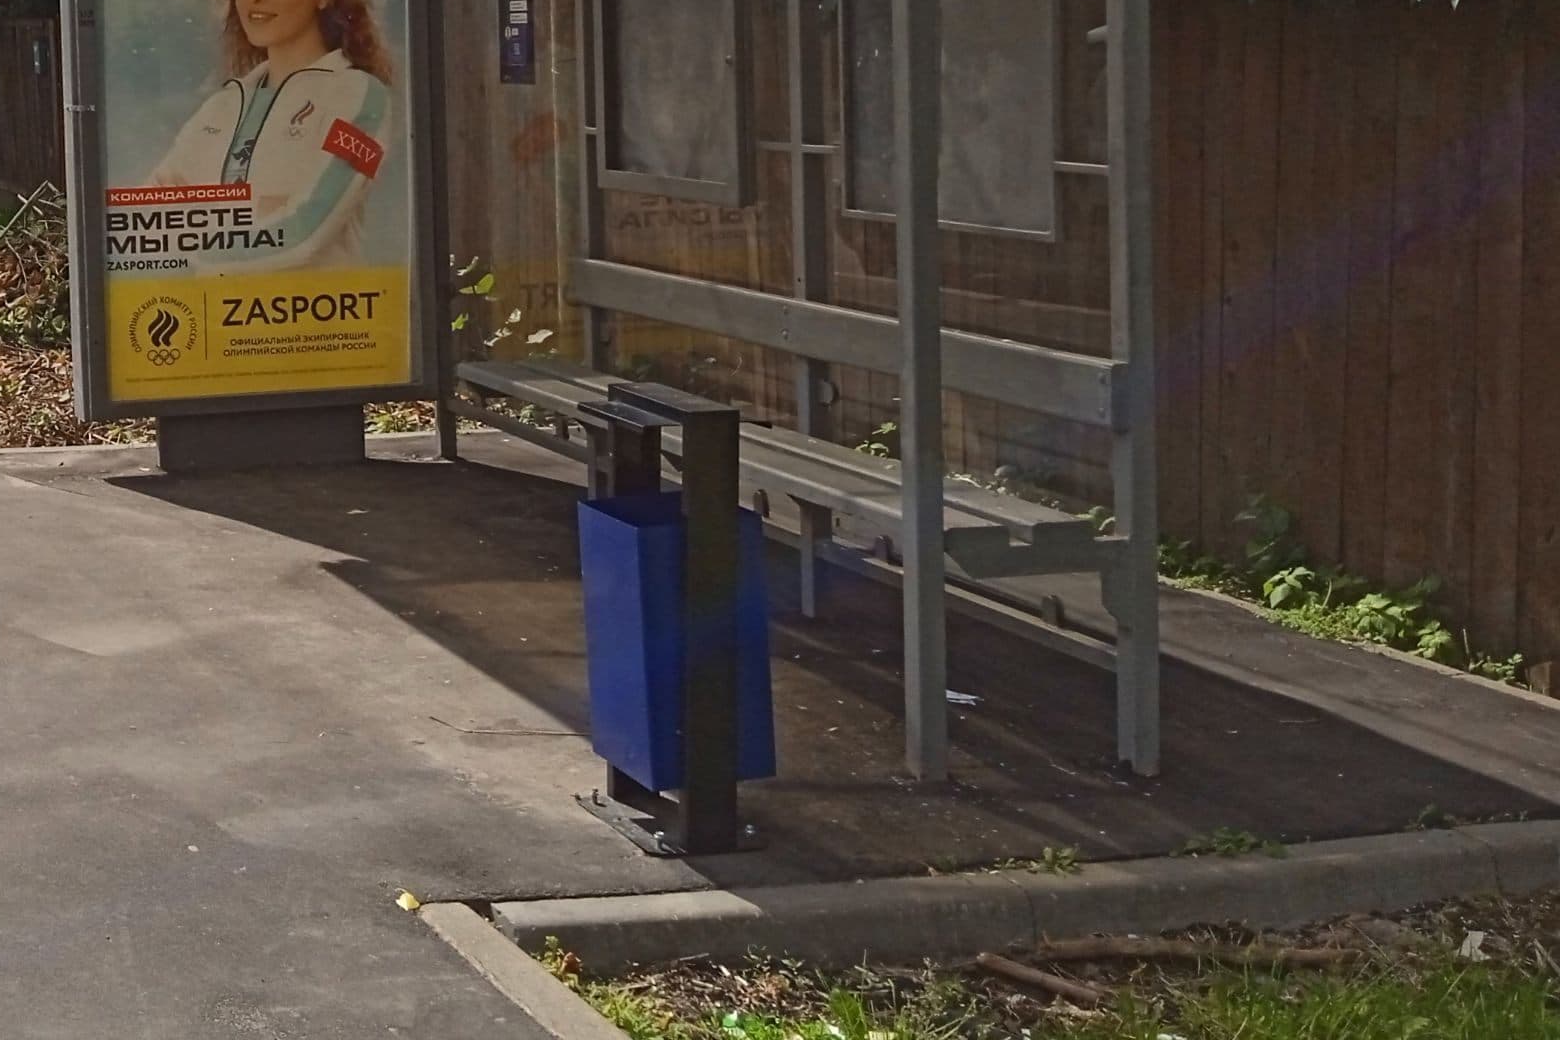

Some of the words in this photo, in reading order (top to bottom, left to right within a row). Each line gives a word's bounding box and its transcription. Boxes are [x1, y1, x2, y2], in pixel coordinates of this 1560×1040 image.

[333, 130, 377, 164] XXIV
[110, 190, 185, 202] КОМАНДА
[187, 187, 247, 199] РОССИИ
[106, 207, 253, 232] ВМЕСТЕ
[106, 233, 169, 255] МЫ
[176, 228, 284, 253] СИЛА!
[107, 258, 189, 272] ZASPORT.COM
[221, 291, 381, 327] ZASPORT
[128, 296, 159, 353] ОЛИМПИЙСКИЙ
[159, 295, 193, 317] КОМИТЕТ
[184, 316, 198, 351] РОССИИ
[222, 344, 294, 358] ОЛИМПИЙСКОЙ
[295, 342, 340, 353] КОМАНДЫ
[341, 340, 377, 351] РОССИИ
[229, 333, 302, 347] ОФИЦИАЛЬНЫЙ
[303, 331, 371, 343] ЭКИПИРОВЩИК
